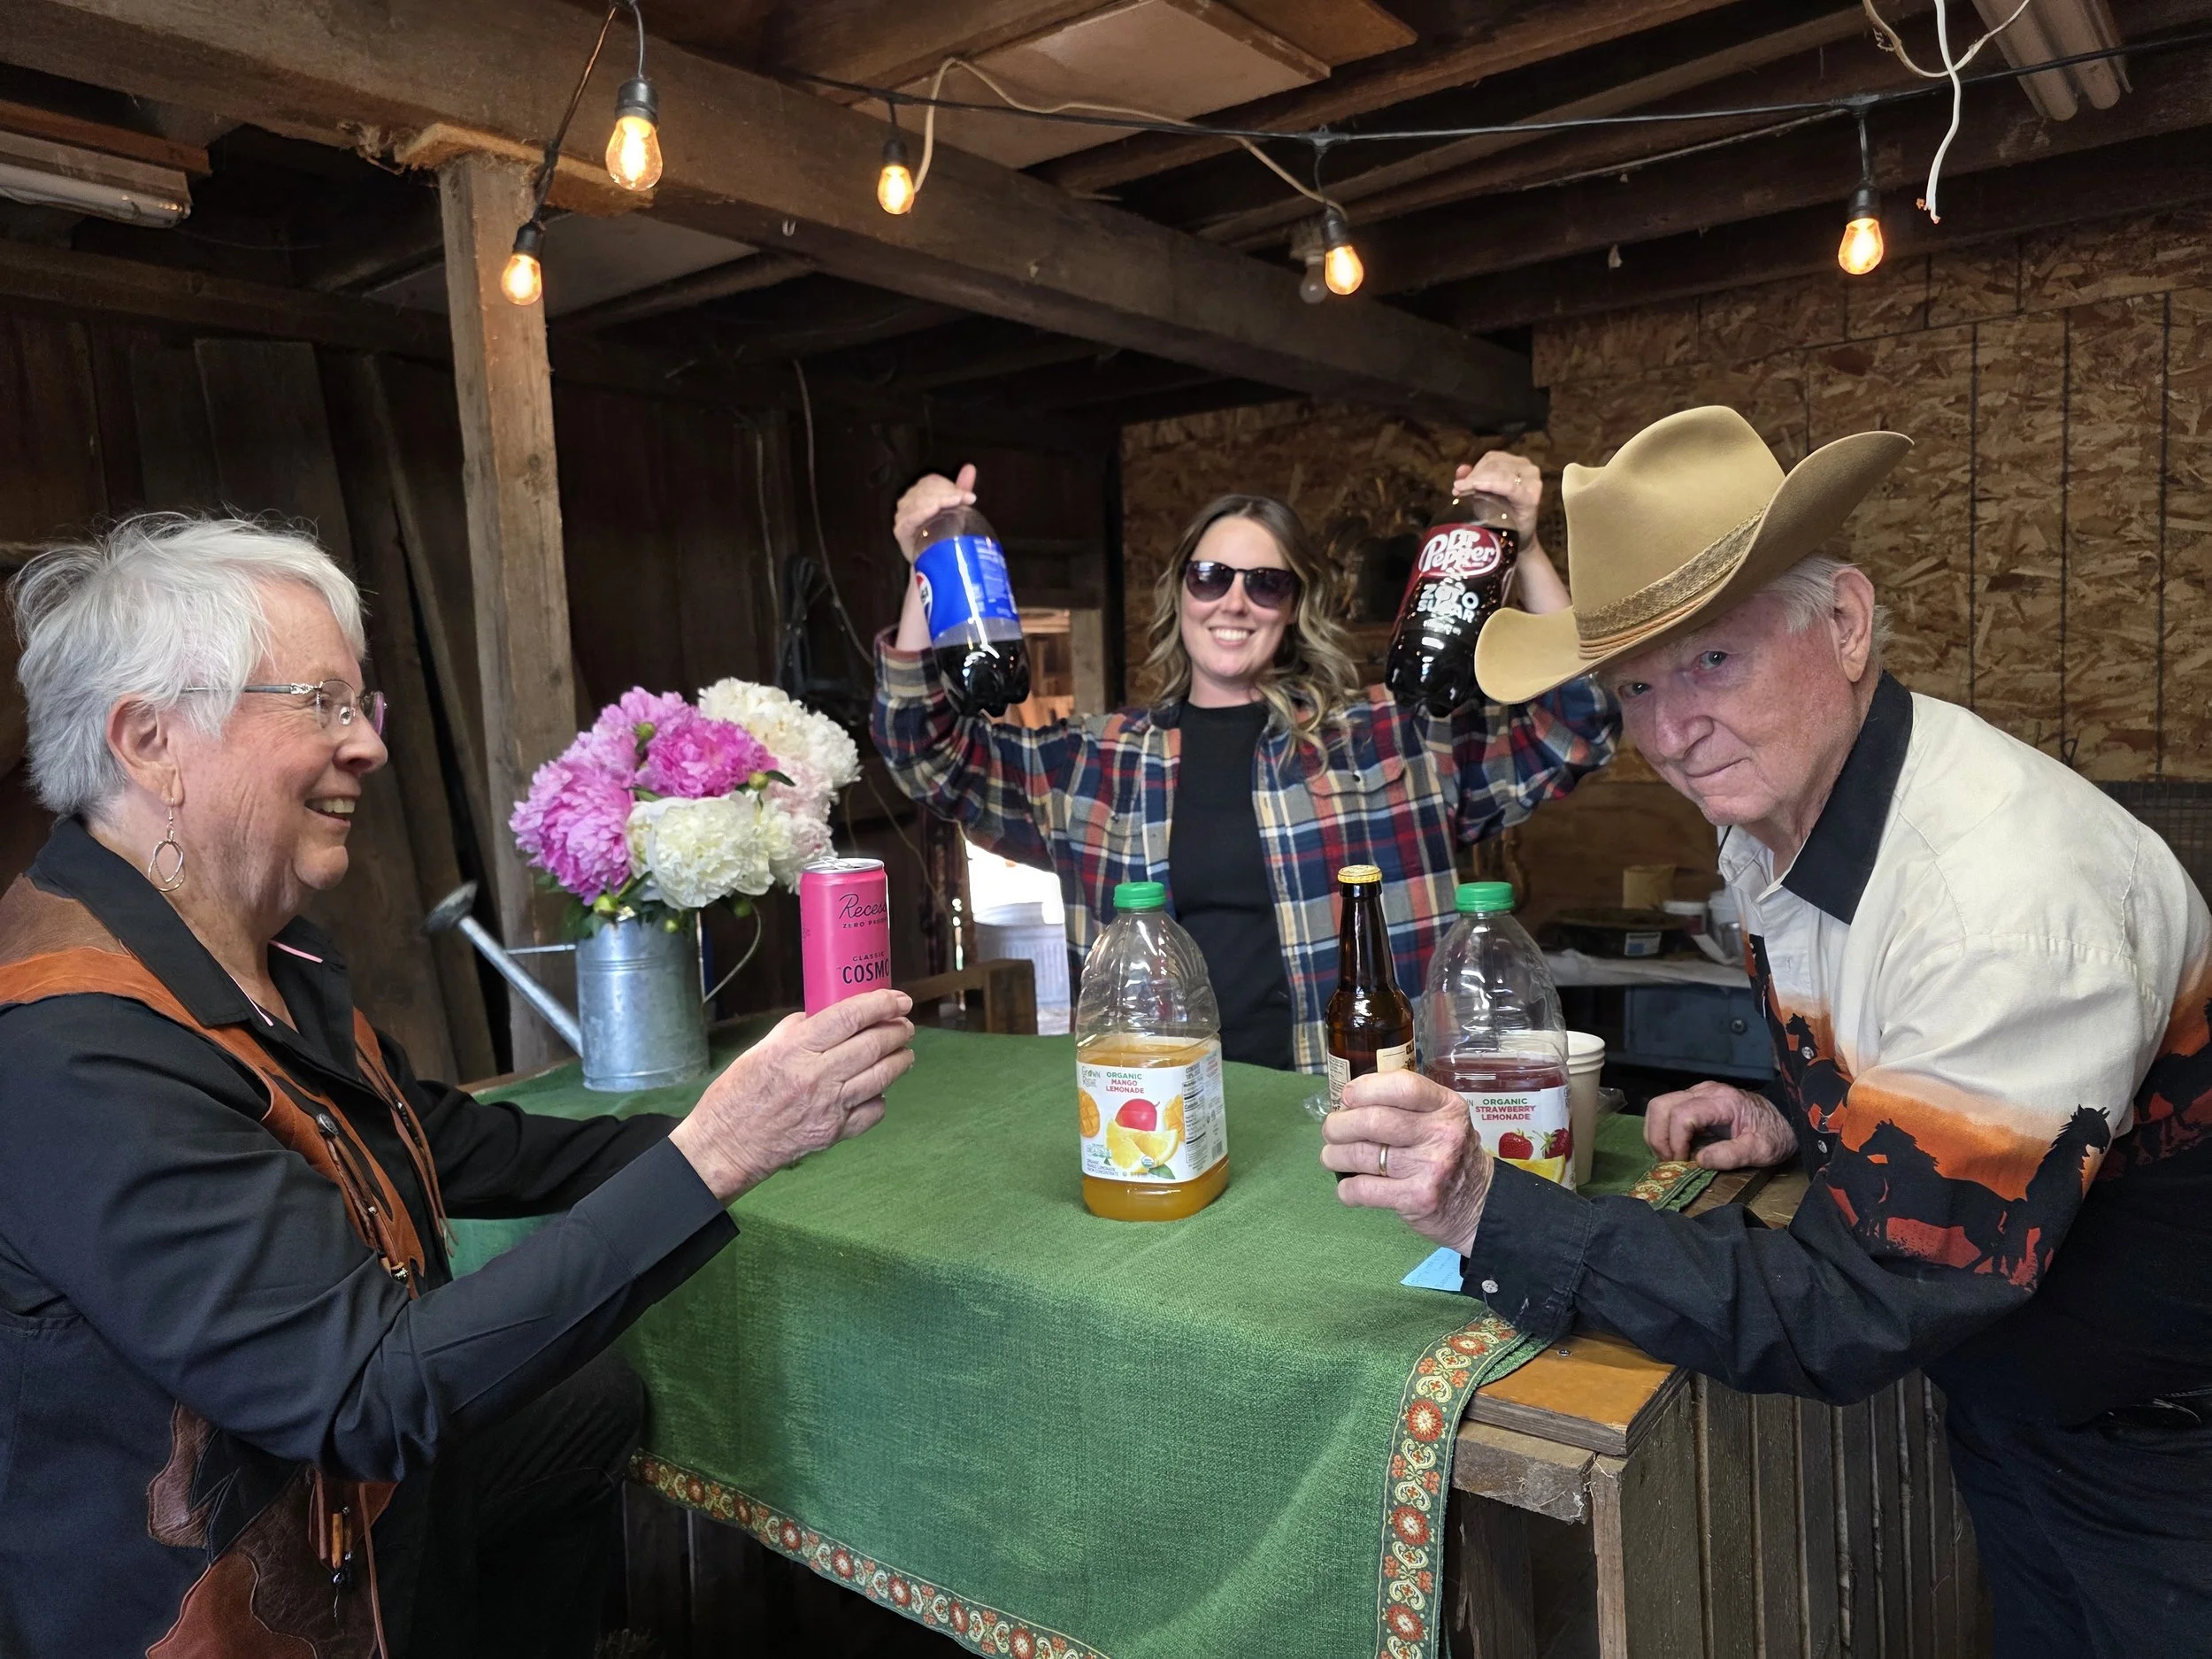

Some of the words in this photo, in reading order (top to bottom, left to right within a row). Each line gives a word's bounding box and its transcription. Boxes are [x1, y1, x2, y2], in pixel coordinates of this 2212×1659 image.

[1418, 533, 1495, 573] Pepper
[1420, 582, 1479, 611] ZO
[1417, 598, 1475, 624] SUAR
[852, 951, 885, 962] CLASSIC
[842, 958, 889, 984] COSMO
[1106, 1071, 1142, 1079] ORGANIC
